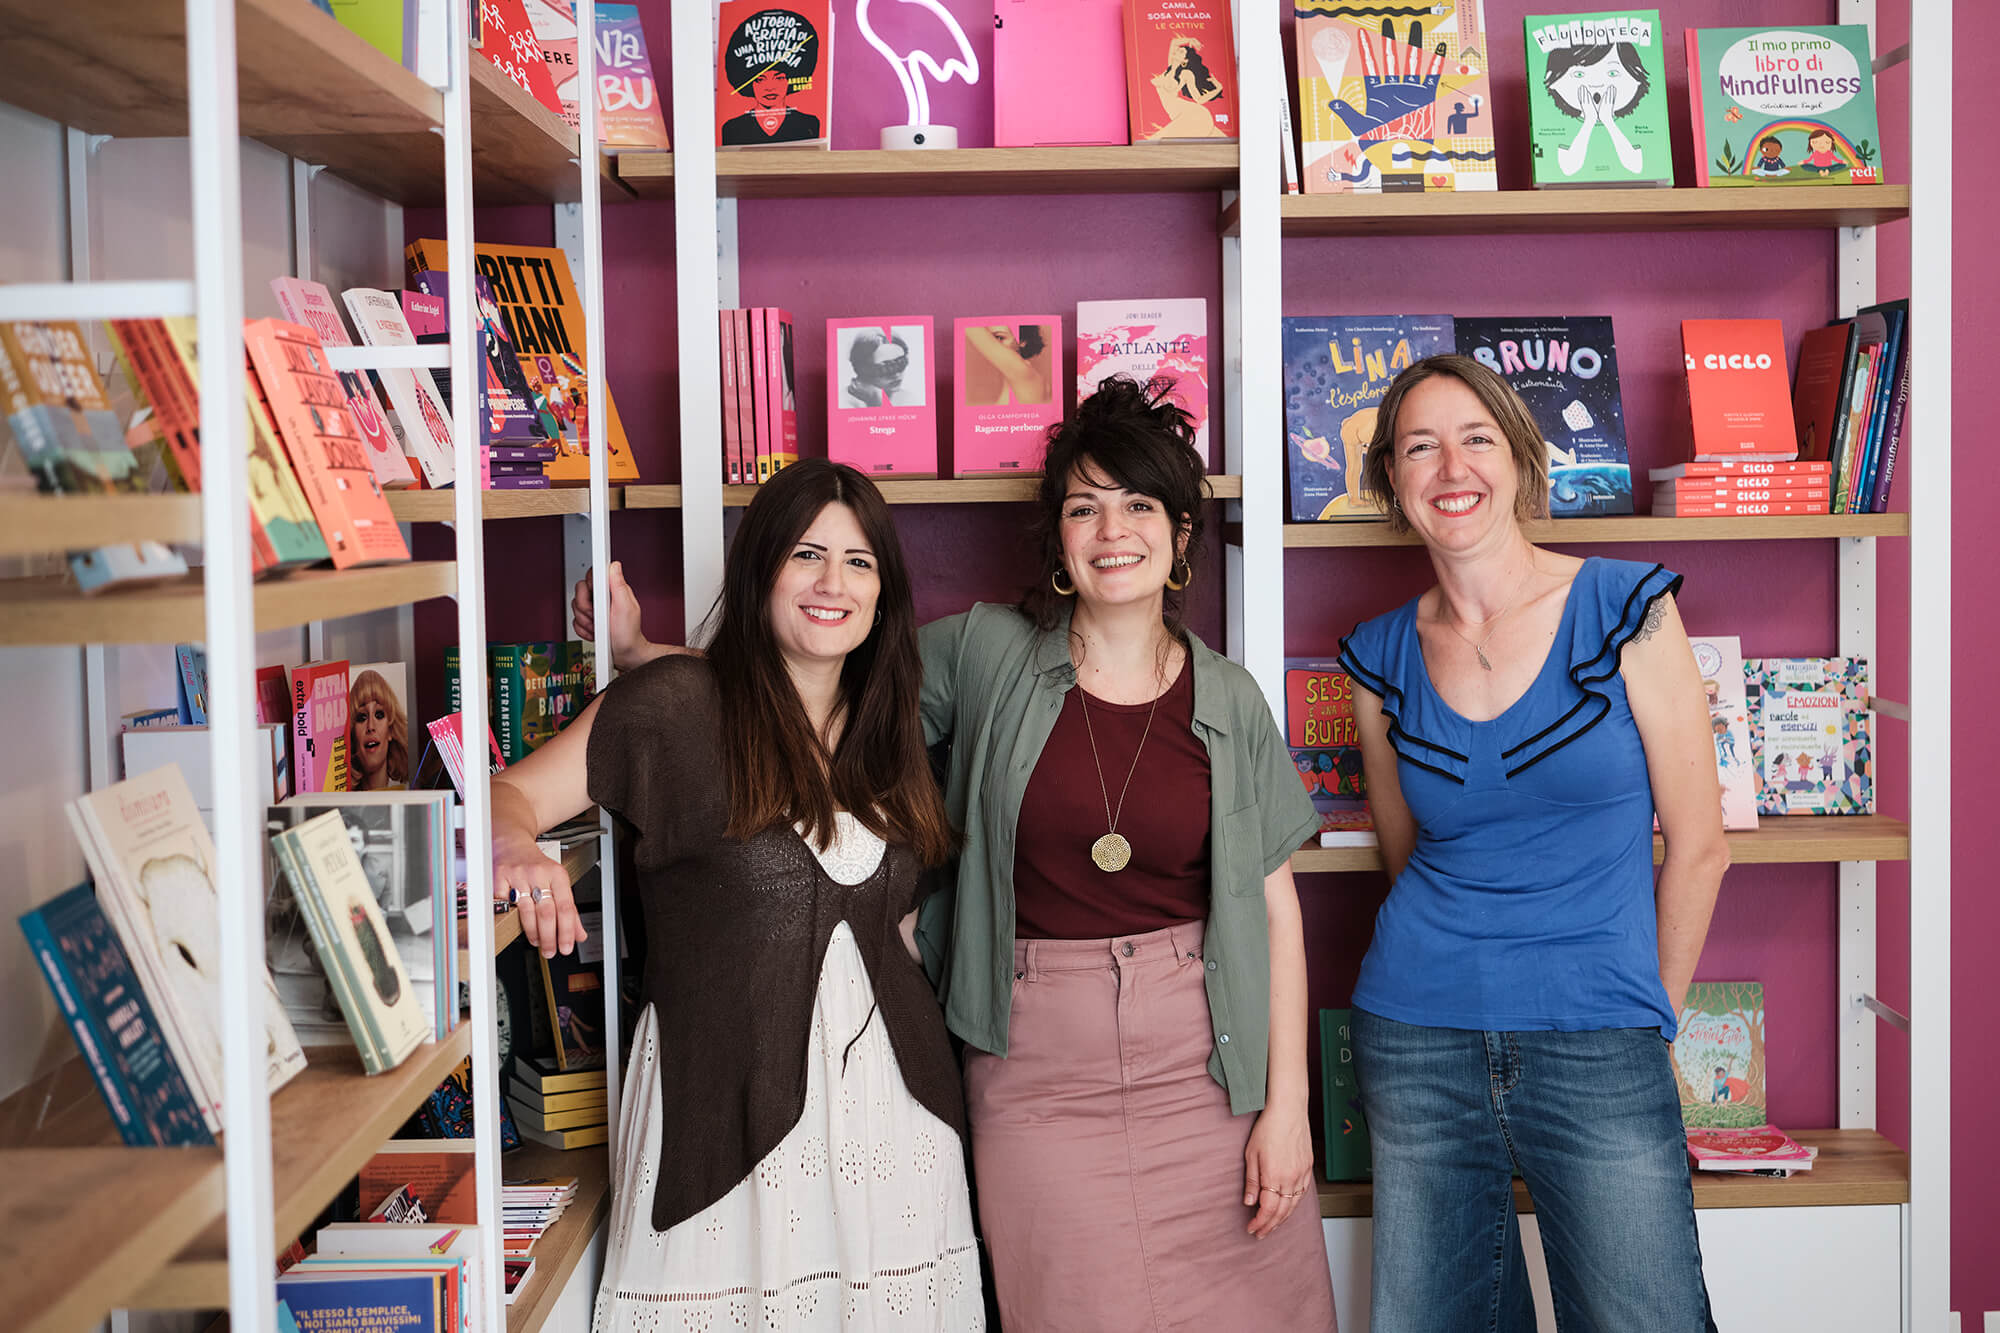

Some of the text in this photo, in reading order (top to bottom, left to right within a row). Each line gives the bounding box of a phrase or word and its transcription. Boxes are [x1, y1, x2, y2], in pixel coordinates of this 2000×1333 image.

[1162, 2, 1196, 10] CAMILA
[1147, 12, 1212, 20] SOSA VILLADA
[744, 16, 802, 37] AUTOBIO-
[1155, 22, 1206, 30] LE CATTIVE
[752, 27, 797, 43] GRAFIA
[1537, 26, 1650, 46] FLUIDOTECA
[734, 43, 754, 57] UNA
[1748, 40, 1832, 54] Il mio primo
[543, 51, 573, 65] ERE
[744, 51, 802, 68] ZIONARIA
[1755, 54, 1823, 72] libro di
[597, 67, 652, 111] BÙ
[1720, 74, 1862, 96] Mindfulness
[1849, 166, 1877, 177] red!
[475, 254, 565, 306] RITTI
[500, 305, 572, 354] ANI
[1100, 341, 1191, 356] L'ATLANTE
[1473, 339, 1602, 379] BRUNO
[1704, 353, 1772, 370] CICLO
[1131, 363, 1157, 371] DELLE
[869, 425, 896, 436] Strega
[975, 423, 1044, 435] Ragazze perbene
[1743, 464, 1774, 473] CICLO
[1736, 478, 1770, 487] CICLO
[1737, 492, 1770, 501] CICLO
[1736, 504, 1769, 513] CICLO
[314, 672, 348, 700] EXTRA
[526, 673, 581, 690] DETRANSITION
[1305, 675, 1353, 704] SESS
[296, 680, 308, 737] extra bold
[539, 694, 572, 716] BABY
[1786, 696, 1839, 709] EMOZIONI
[315, 698, 348, 733] BOLD
[500, 677, 511, 757] DETRANSITION
[1769, 711, 1799, 721] parole
[1304, 717, 1358, 746] BUFF
[1781, 722, 1818, 732] esercizi
[312, 1308, 345, 1319] SESSO
[347, 1305, 354, 1317] È
[356, 1305, 411, 1317] SEMPLICE,
[304, 1320, 324, 1329] NOI
[325, 1318, 359, 1328] SIAMO
[361, 1315, 421, 1326] BRAVISSIMI
